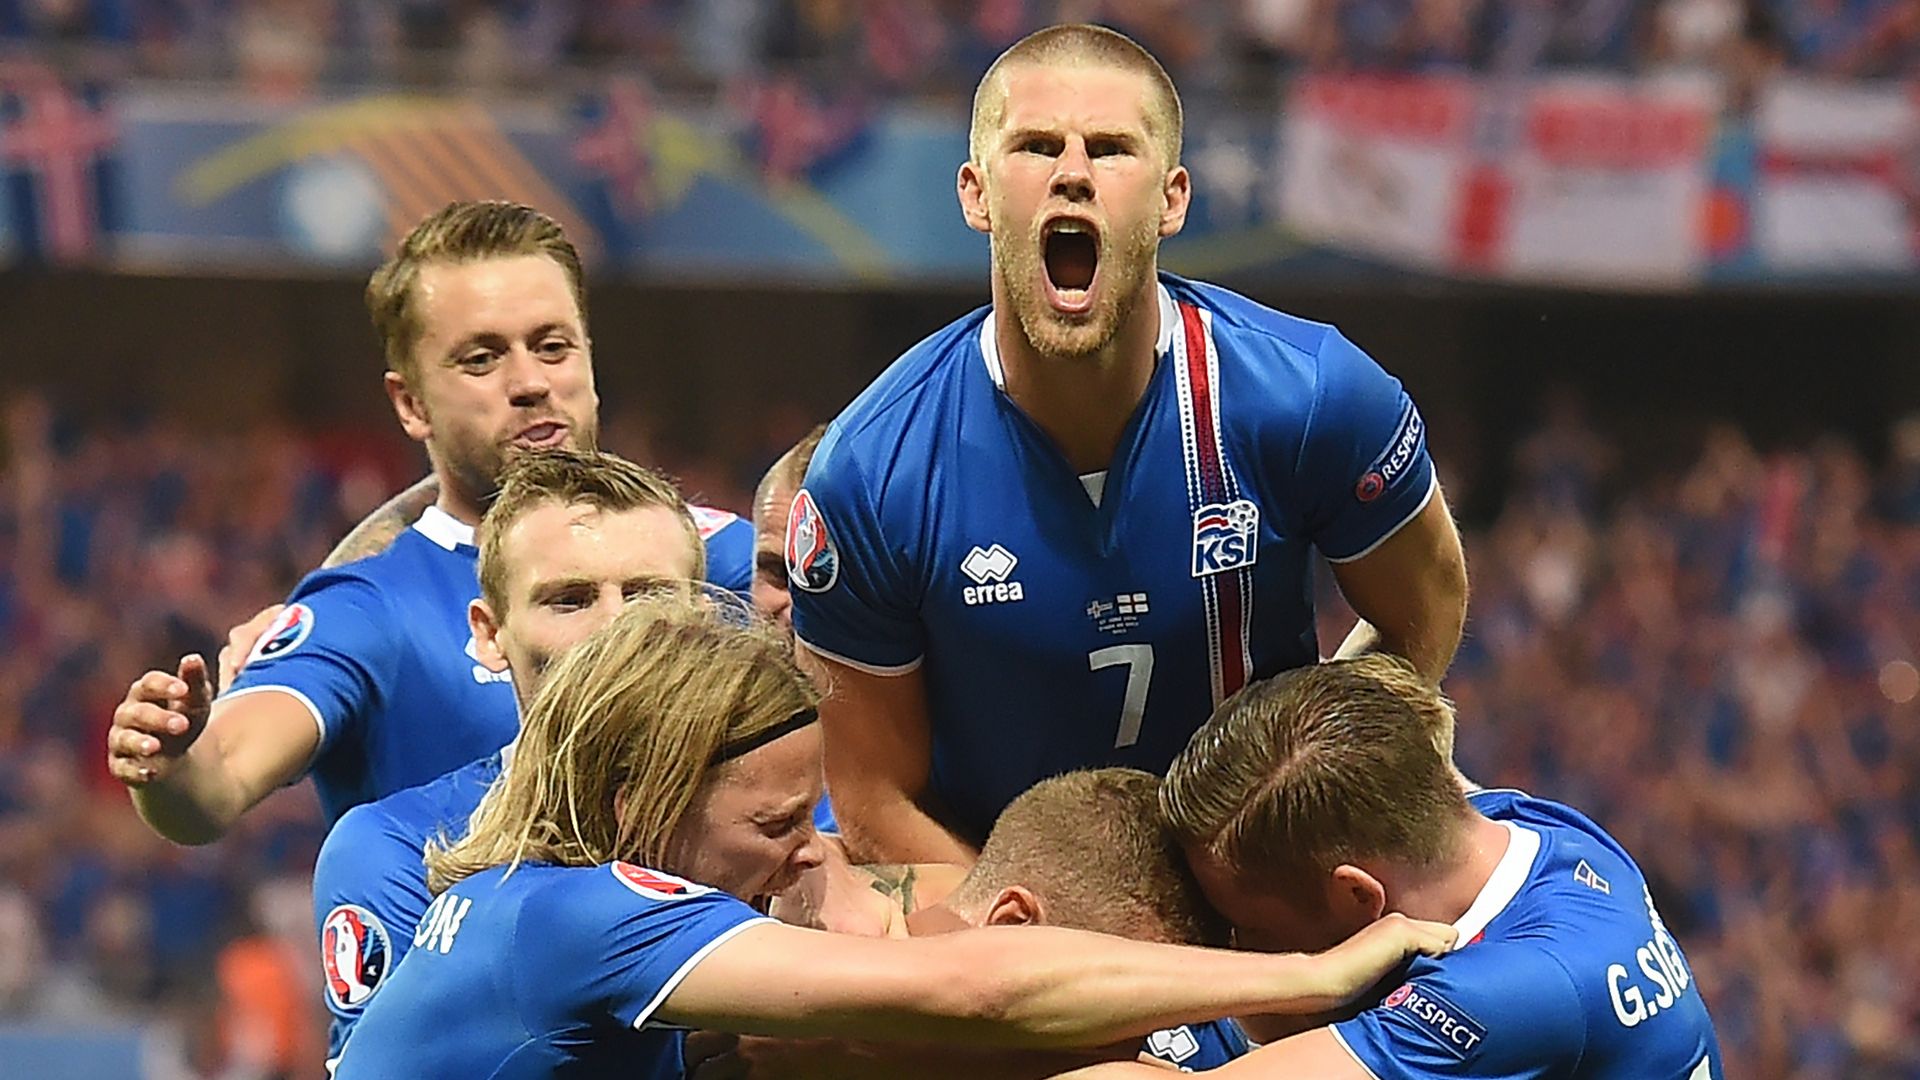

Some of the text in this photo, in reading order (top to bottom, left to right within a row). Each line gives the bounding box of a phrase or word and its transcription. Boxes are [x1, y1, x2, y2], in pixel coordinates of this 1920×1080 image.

[963, 581, 1023, 605] errea
[1088, 643, 1154, 748] 7
[1607, 884, 1690, 1028] G.SIG
[1402, 992, 1480, 1050] RESPECT
